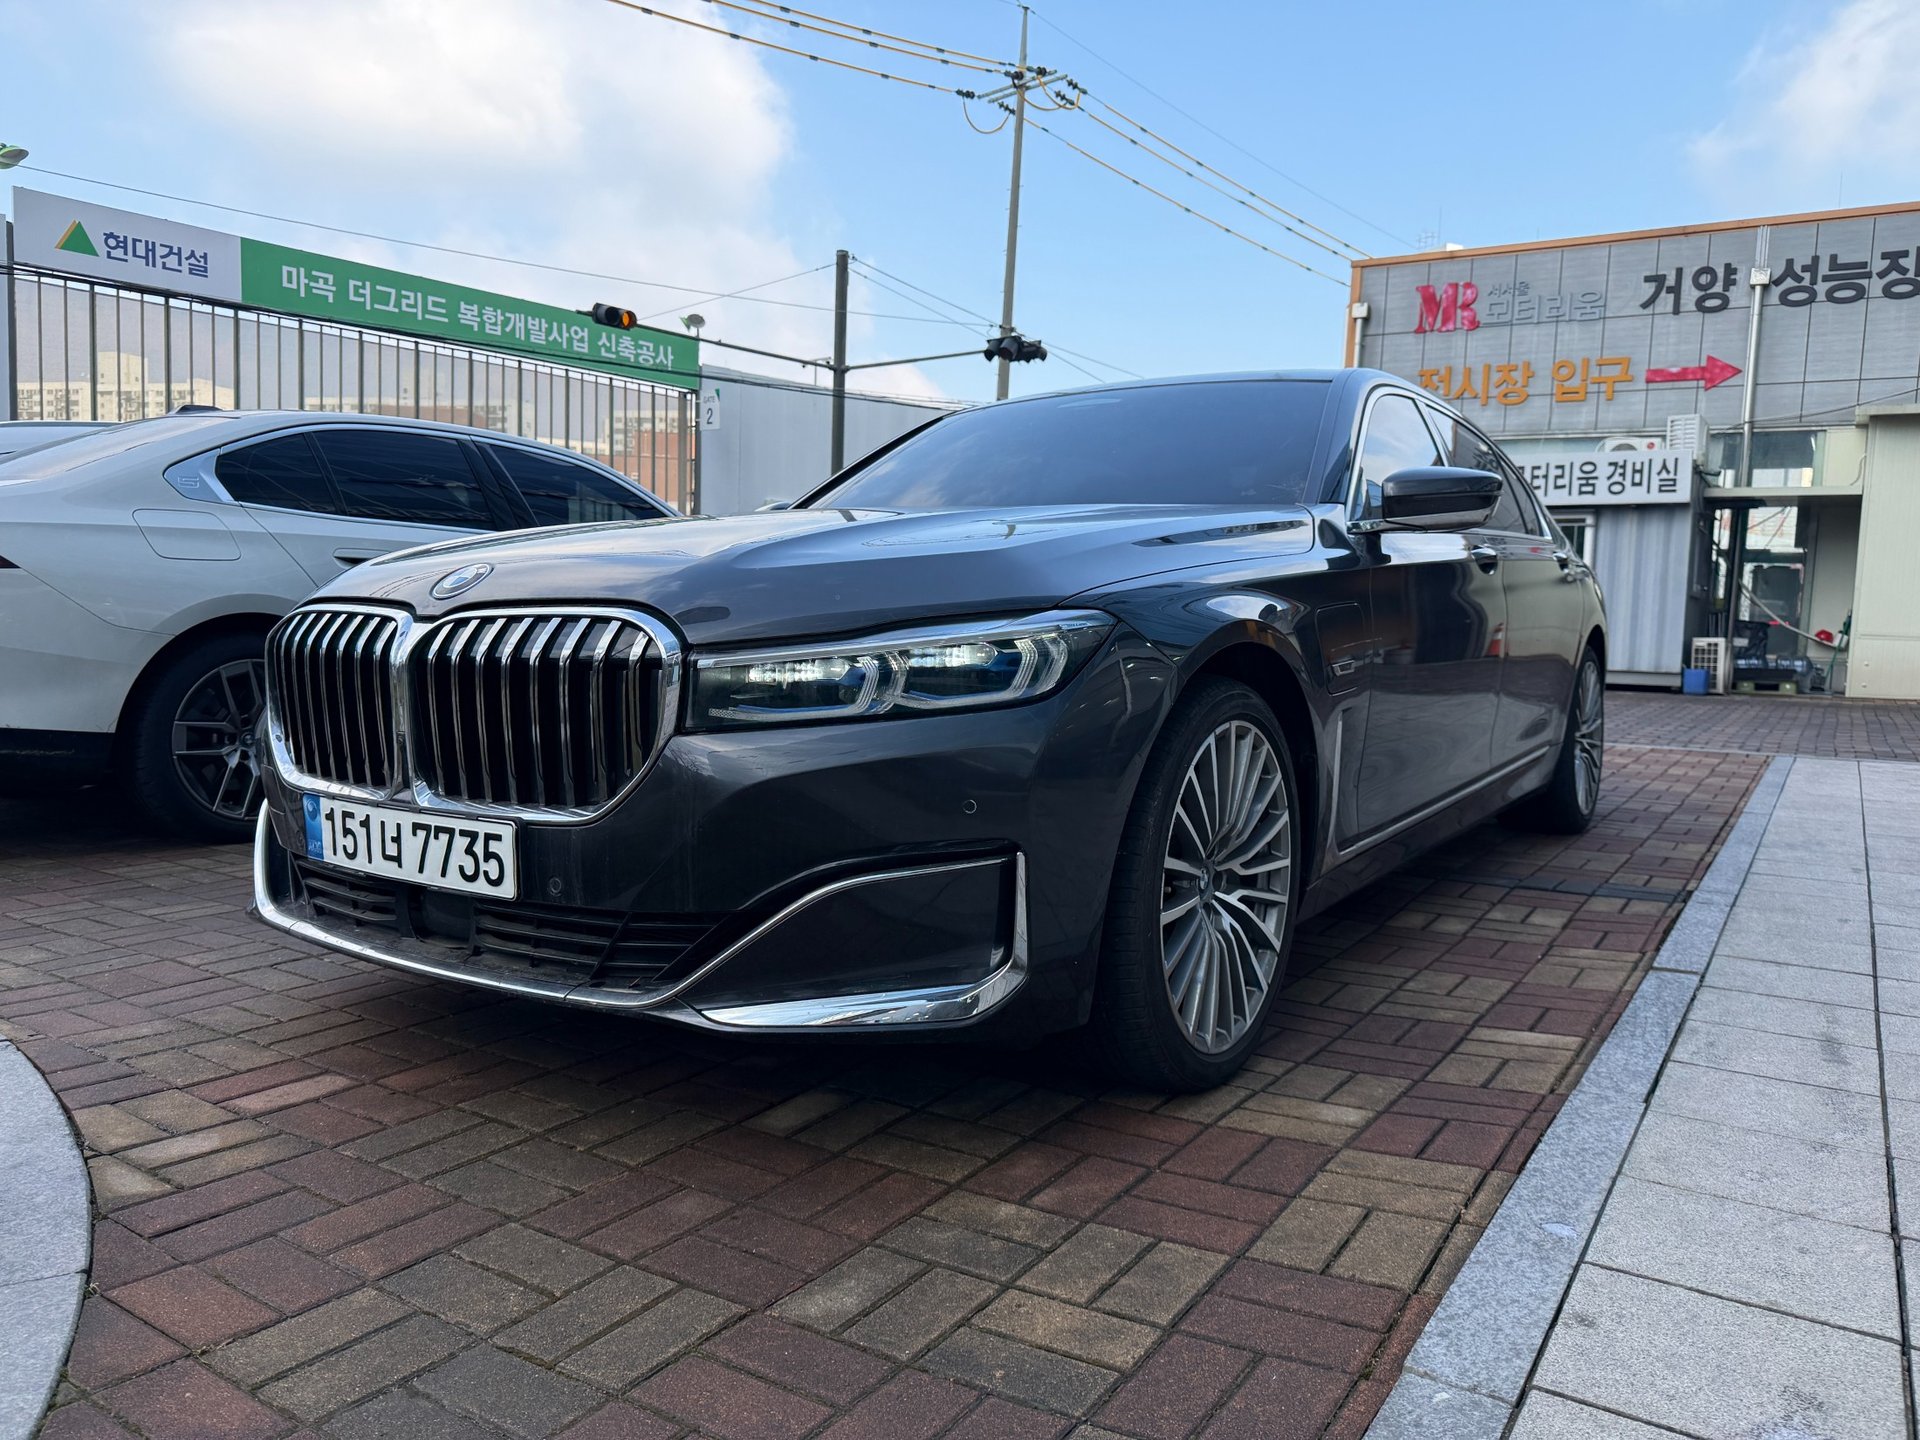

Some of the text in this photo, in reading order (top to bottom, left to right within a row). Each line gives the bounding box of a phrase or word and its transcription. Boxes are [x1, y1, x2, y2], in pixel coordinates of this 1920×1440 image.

[103, 231, 209, 279] 현대건설
[1483, 291, 1606, 326] 모터리움
[1639, 262, 1738, 316] 거양
[282, 265, 674, 371] 마곡 더그리드 복합개발사업 신축공사
[1552, 357, 1634, 404] 입구
[706, 407, 713, 425] 2
[1517, 457, 1679, 497] 터리움 경비실
